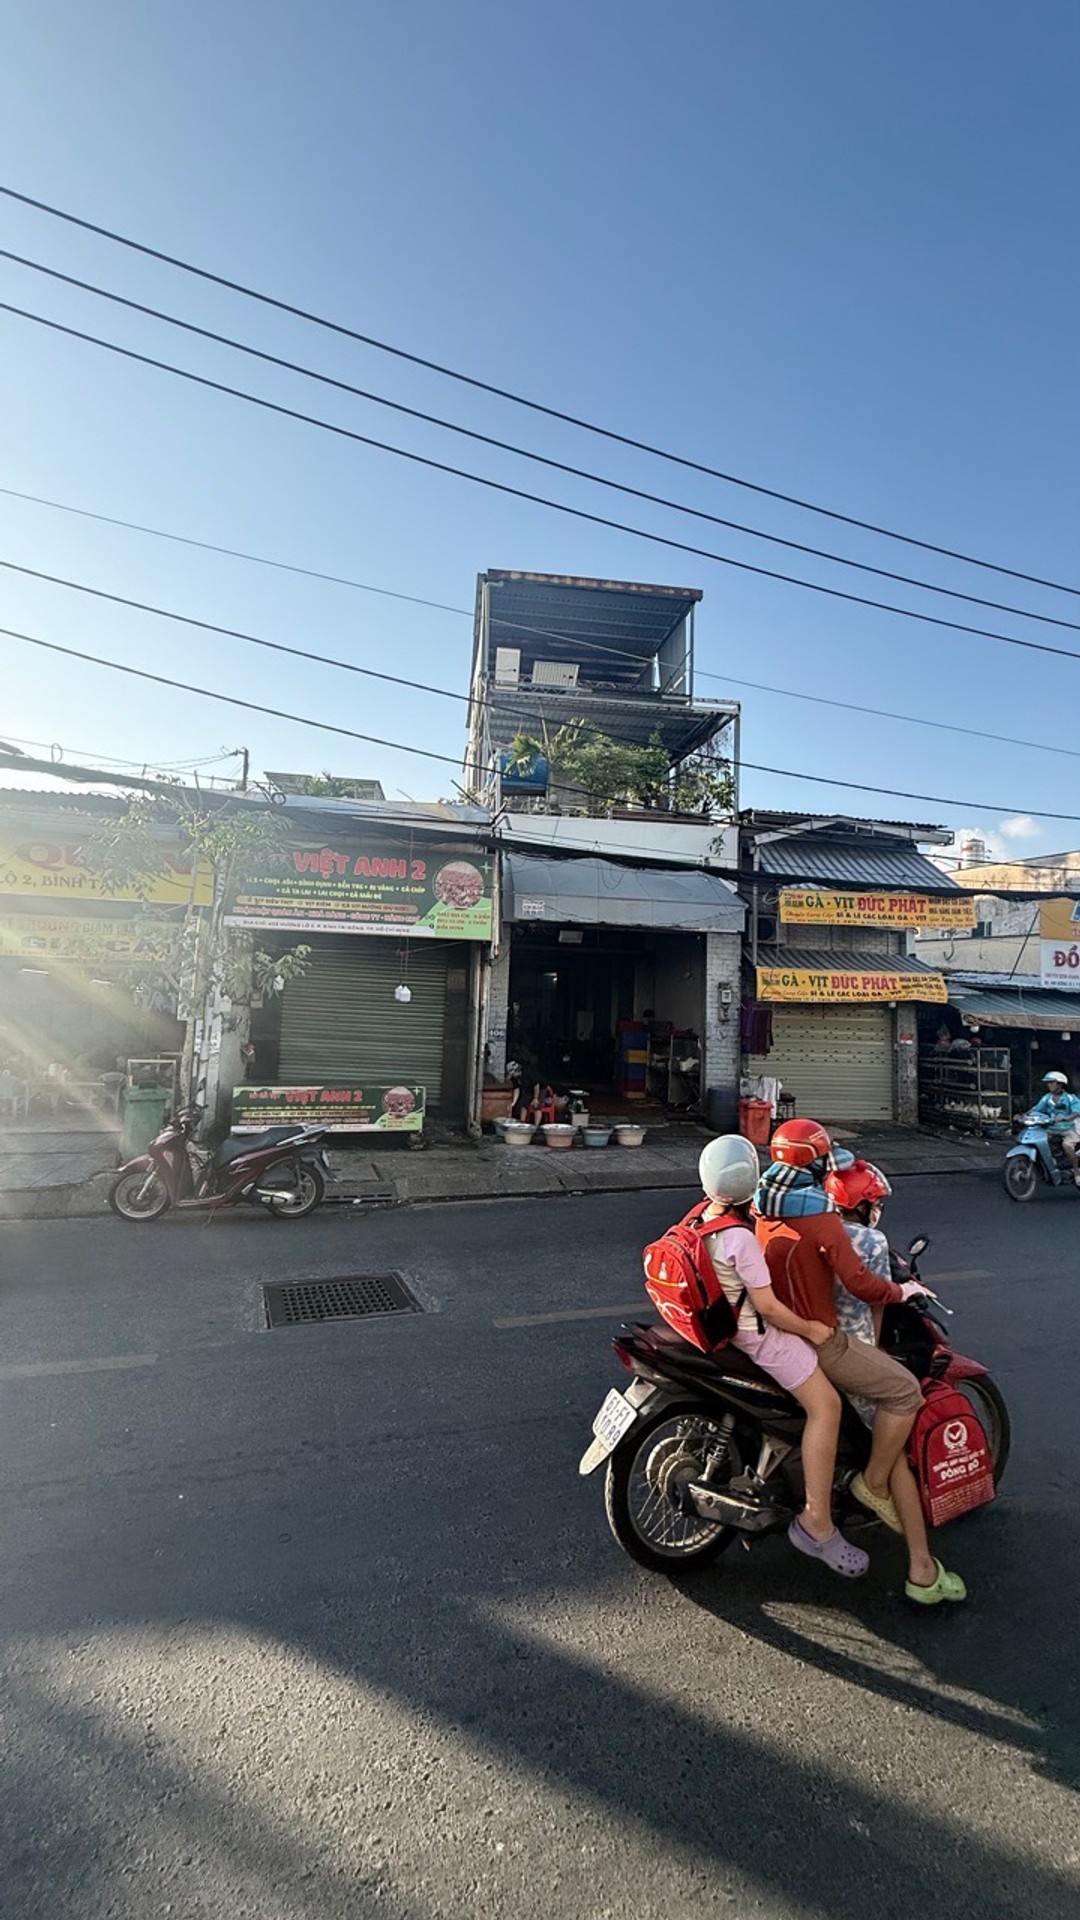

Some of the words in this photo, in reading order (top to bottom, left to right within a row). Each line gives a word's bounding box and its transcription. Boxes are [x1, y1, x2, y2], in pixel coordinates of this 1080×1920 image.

[293, 848, 350, 880] VIỆT
[353, 856, 406, 879] ANH
[411, 859, 426, 880] 2
[42, 873, 83, 888] BÌNH
[805, 892, 824, 908] GÀ
[833, 897, 855, 912] VỊT
[857, 895, 885, 912] ĐỨC
[888, 896, 927, 913] PHÁT
[781, 971, 799, 987] GÀ
[808, 975, 829, 990] VỊT
[831, 973, 859, 990] ĐỨC
[861, 975, 898, 990] PHÁT
[285, 1089, 317, 1105] VIỆT
[320, 1090, 352, 1102] ANH
[353, 1089, 363, 1102] 2
[941, 1464, 967, 1481] ĐÔNG
